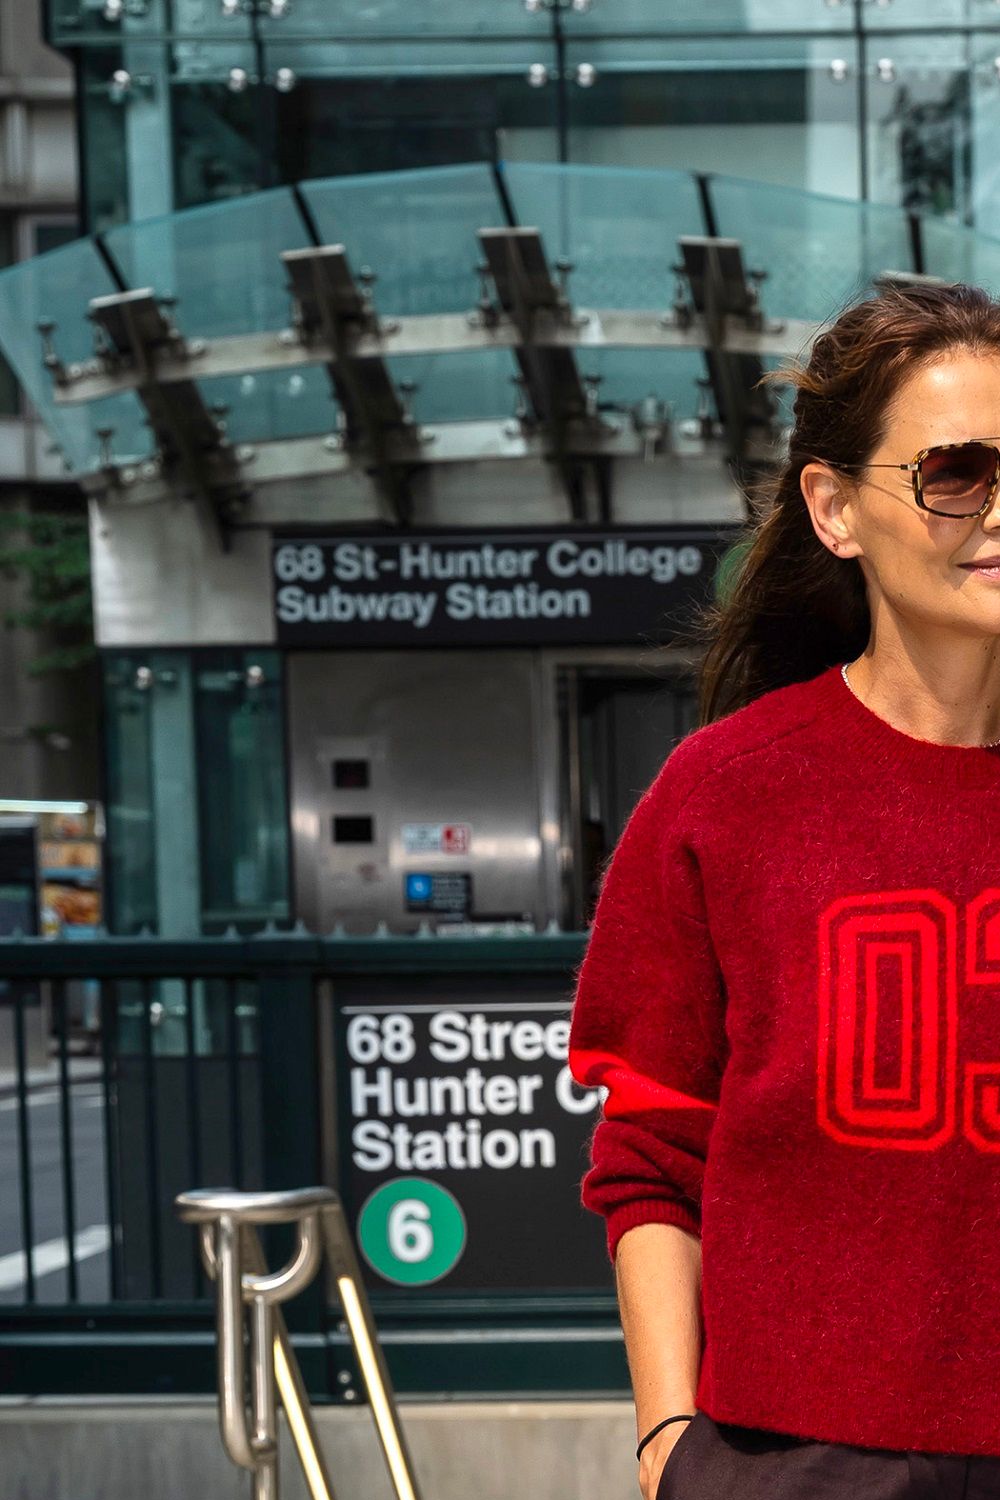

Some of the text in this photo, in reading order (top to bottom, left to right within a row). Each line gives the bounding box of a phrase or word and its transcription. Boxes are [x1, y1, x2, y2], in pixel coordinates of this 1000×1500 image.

[276, 540, 701, 583] 68 St-Hunter College
[278, 582, 591, 628] Subway Station
[347, 1010, 570, 1064] 68 Stree
[351, 1066, 543, 1117] Hunter
[352, 1118, 556, 1171] Station
[388, 1198, 434, 1263] 6
